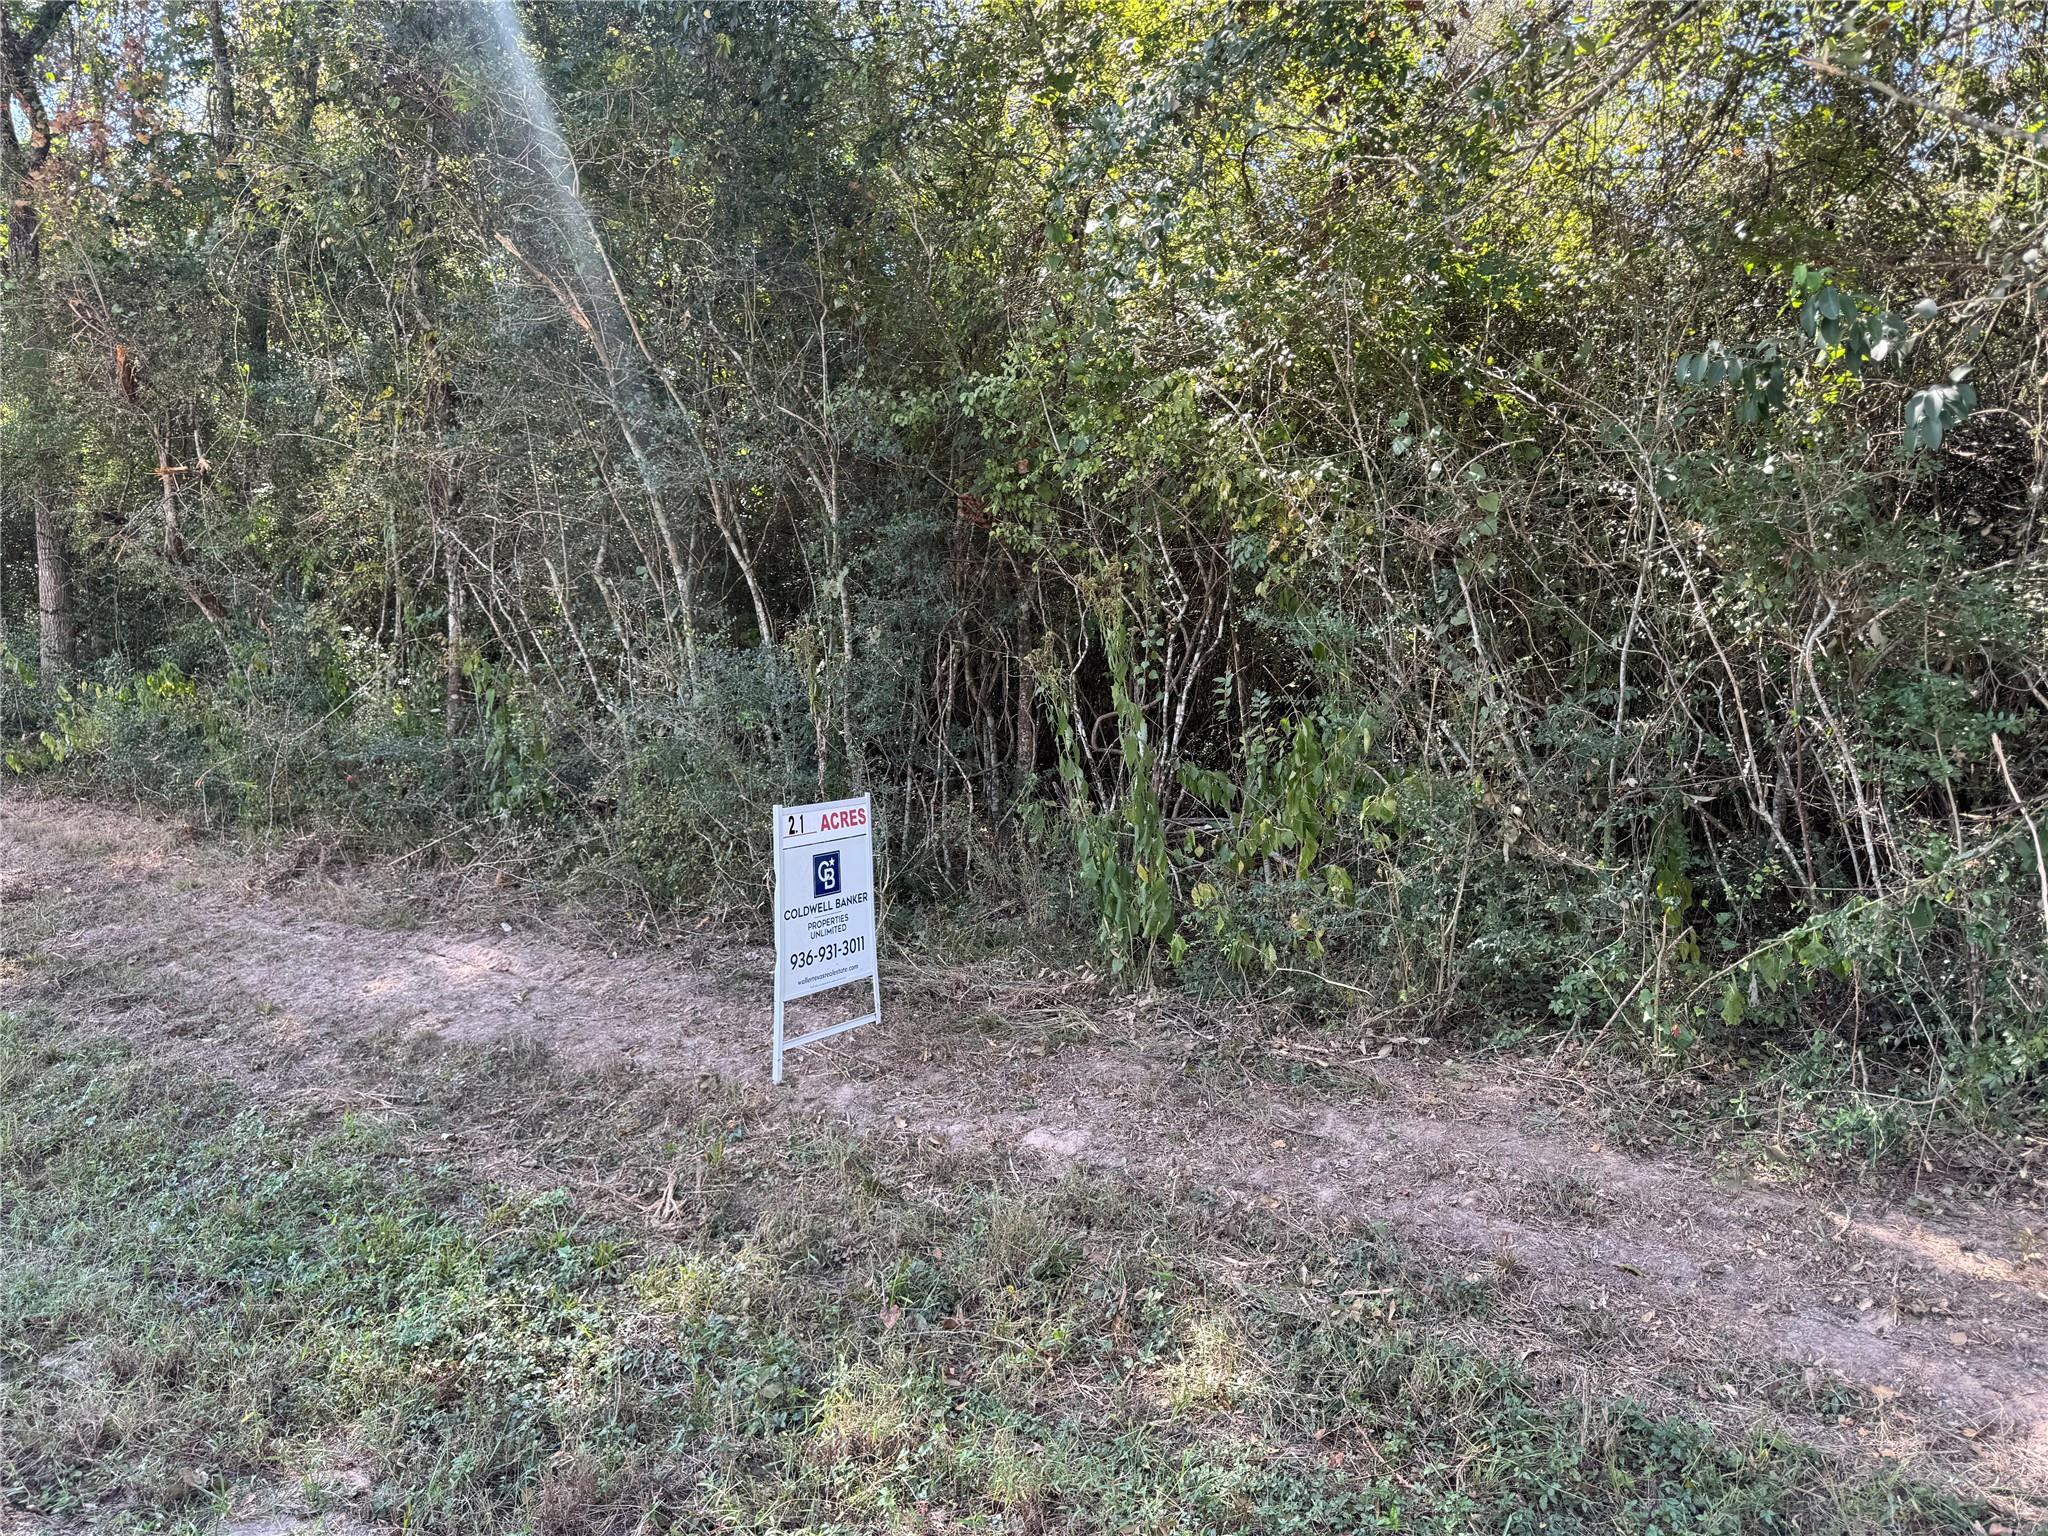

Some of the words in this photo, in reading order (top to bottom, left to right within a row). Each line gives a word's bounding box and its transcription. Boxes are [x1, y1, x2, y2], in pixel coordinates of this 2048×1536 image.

[788, 814, 804, 835] 2.1
[820, 808, 867, 832] ACRES
[784, 900, 833, 920] COLDWELL
[835, 892, 868, 909] BANKER
[807, 913, 849, 931] PROPERTIES
[810, 923, 847, 940] UNLIMITED
[790, 935, 865, 970] 936-931-3011
